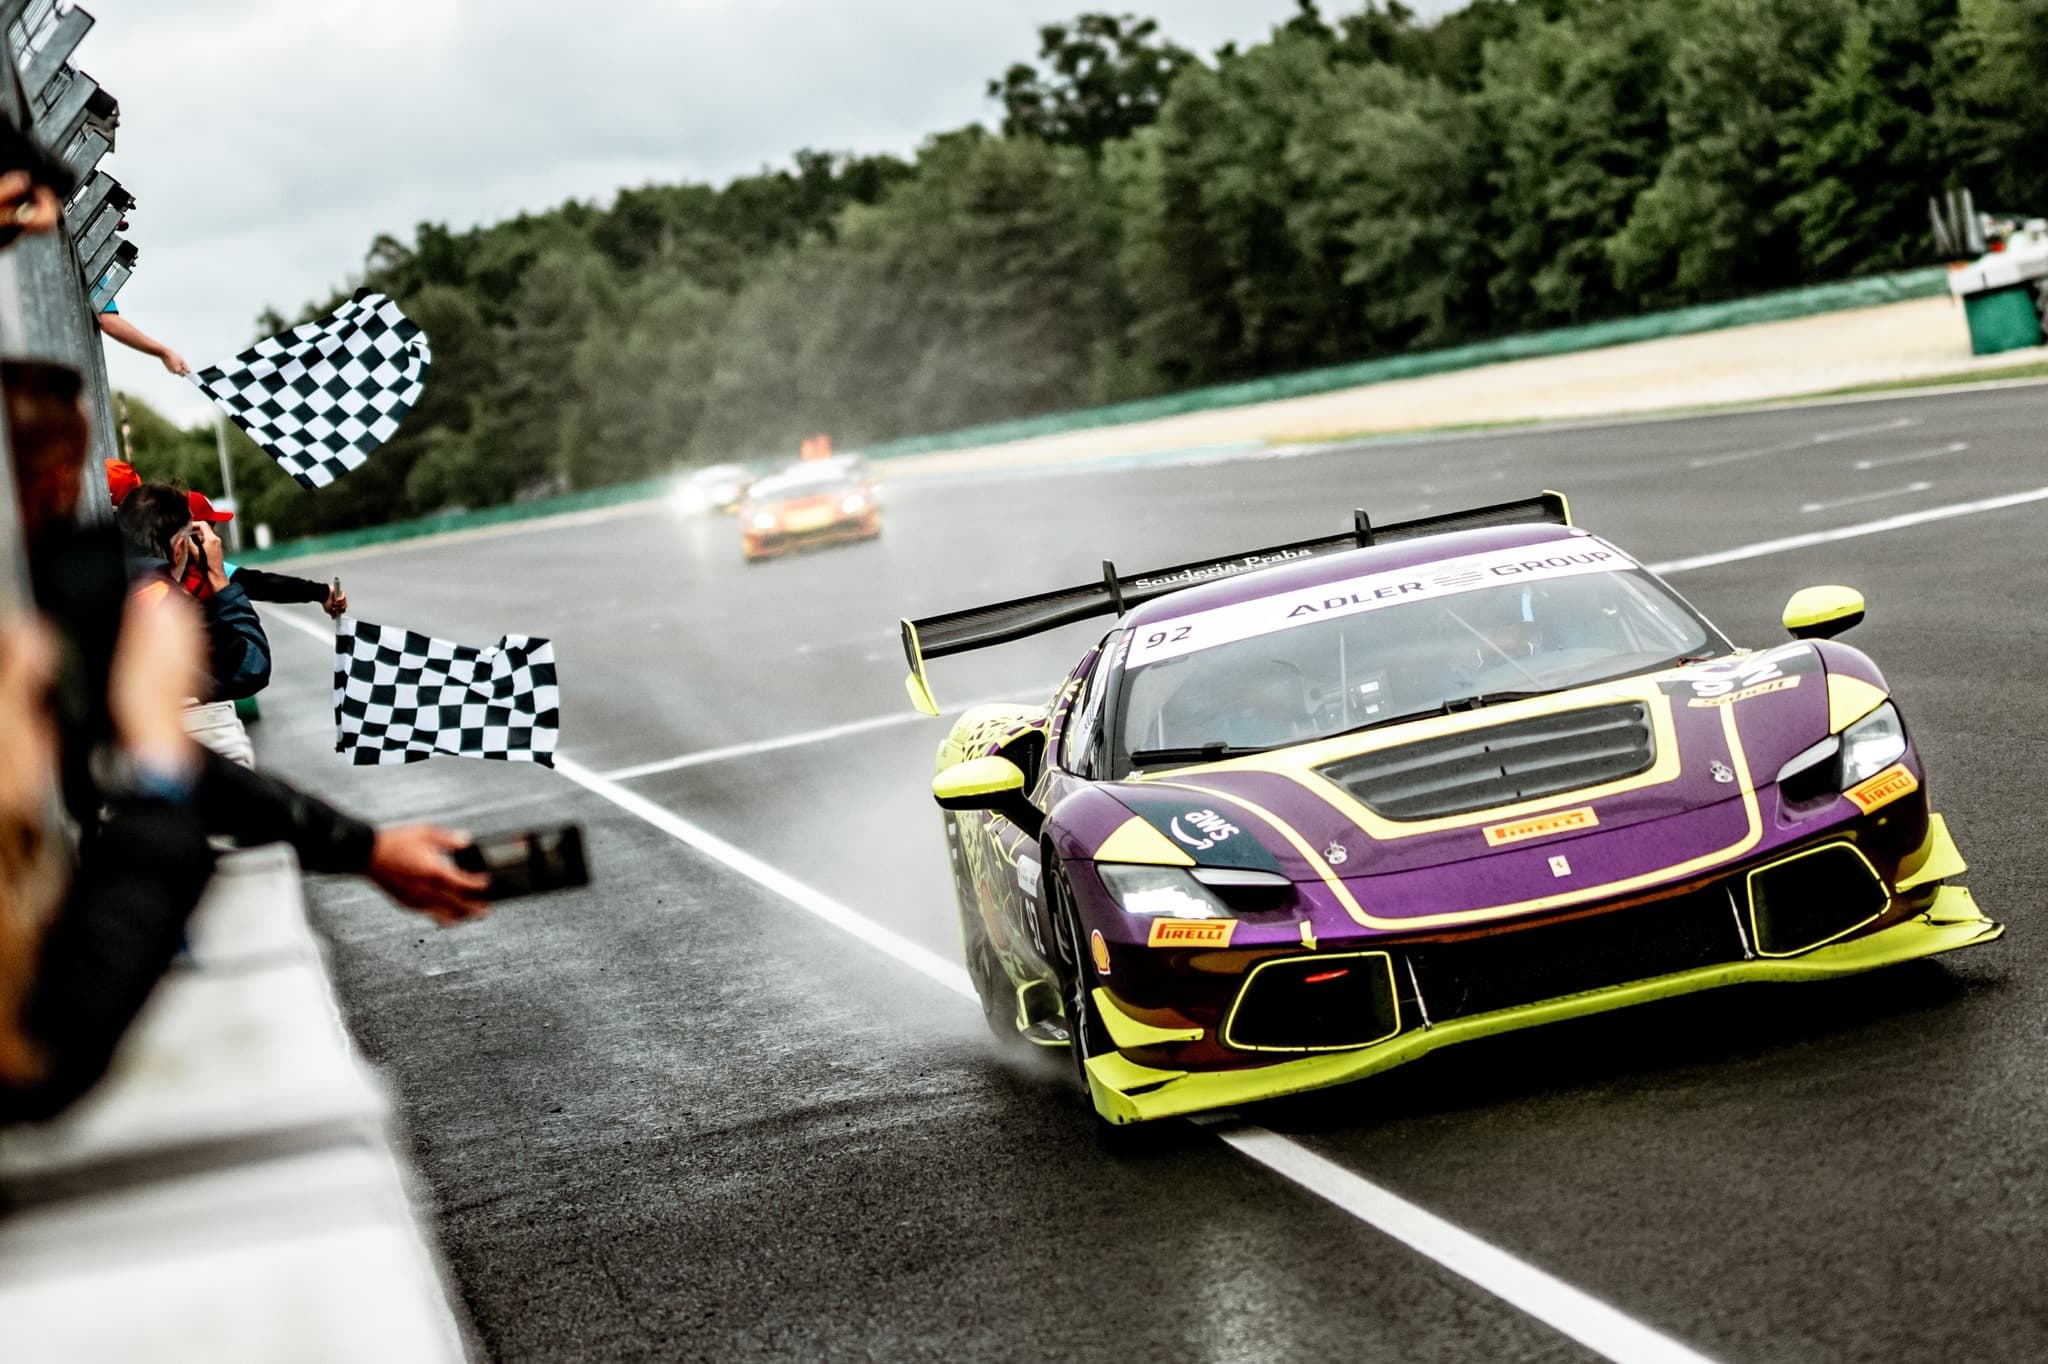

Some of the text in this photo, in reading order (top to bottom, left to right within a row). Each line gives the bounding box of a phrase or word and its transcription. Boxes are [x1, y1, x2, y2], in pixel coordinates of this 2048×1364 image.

[1145, 550, 1613, 649] 92 ADLER GROUP
[1854, 770, 1912, 806] PIRELLI
[1184, 809, 1240, 841] aws
[1156, 923, 1227, 940] PIRELLI
